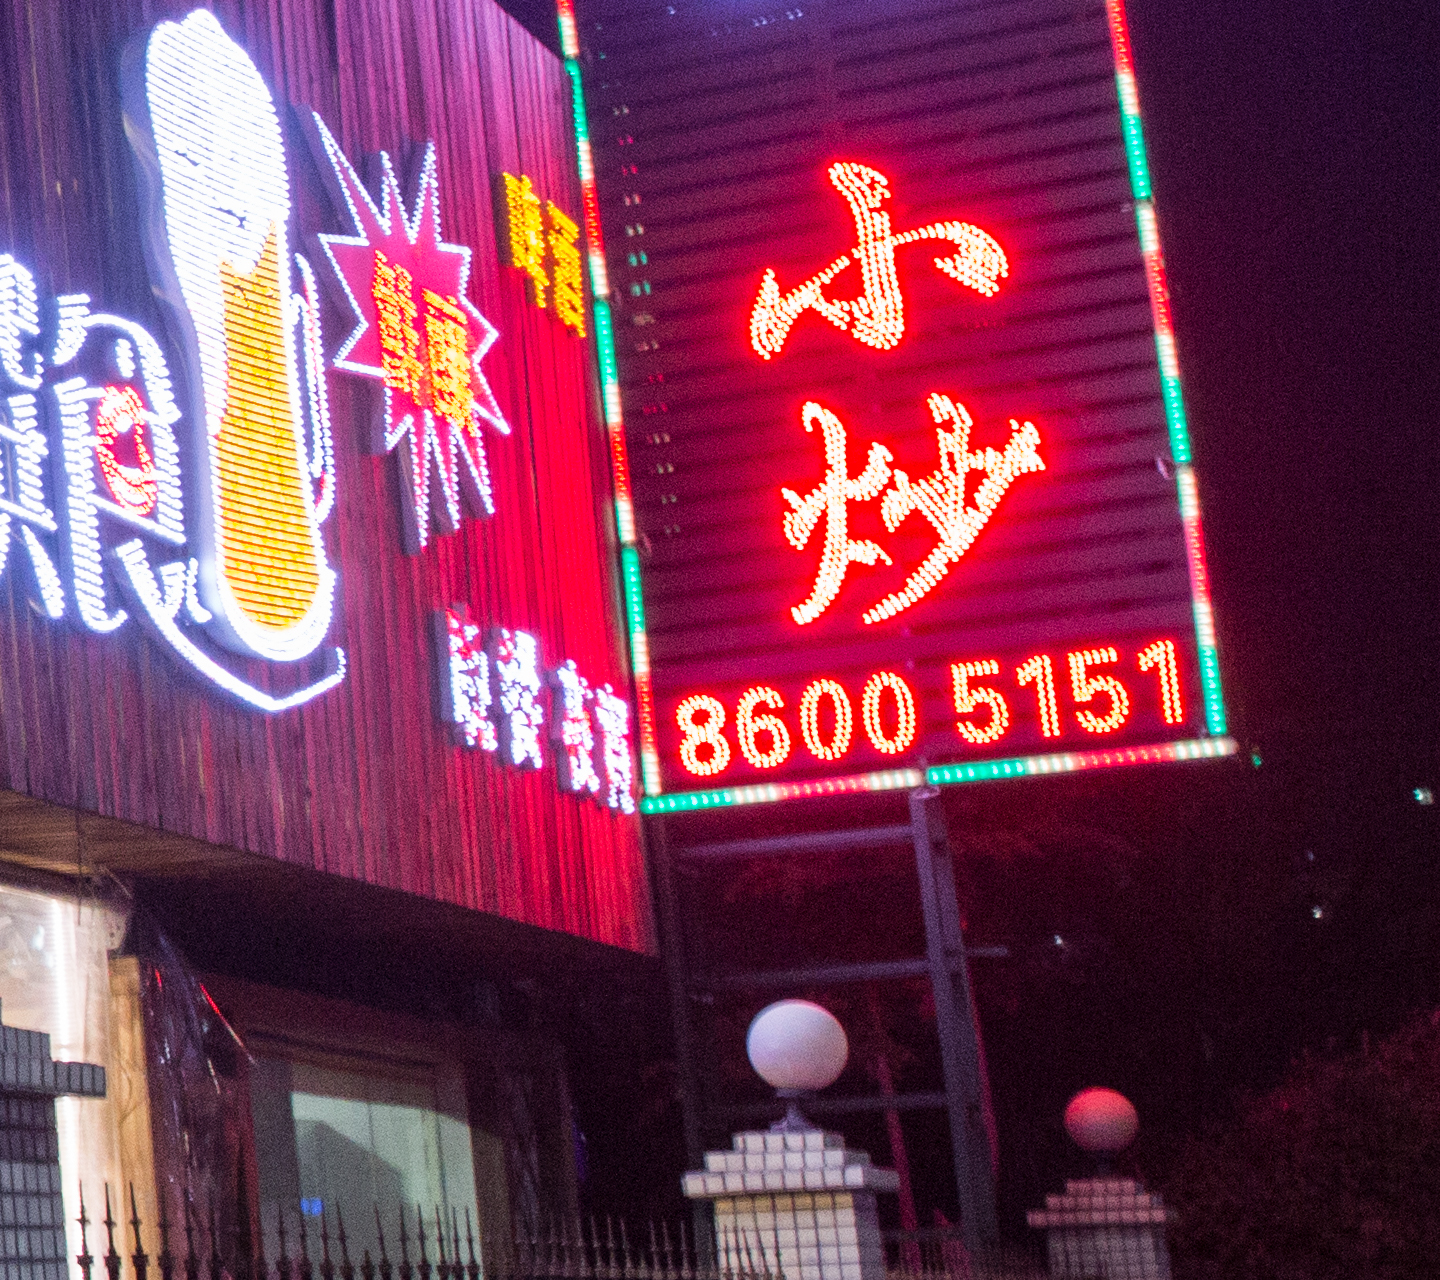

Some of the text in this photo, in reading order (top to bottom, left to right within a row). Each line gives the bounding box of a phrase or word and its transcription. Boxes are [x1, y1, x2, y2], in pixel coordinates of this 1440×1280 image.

[749, 160, 1046, 626] 小炒
[676, 639, 1184, 776] 8600 5151
